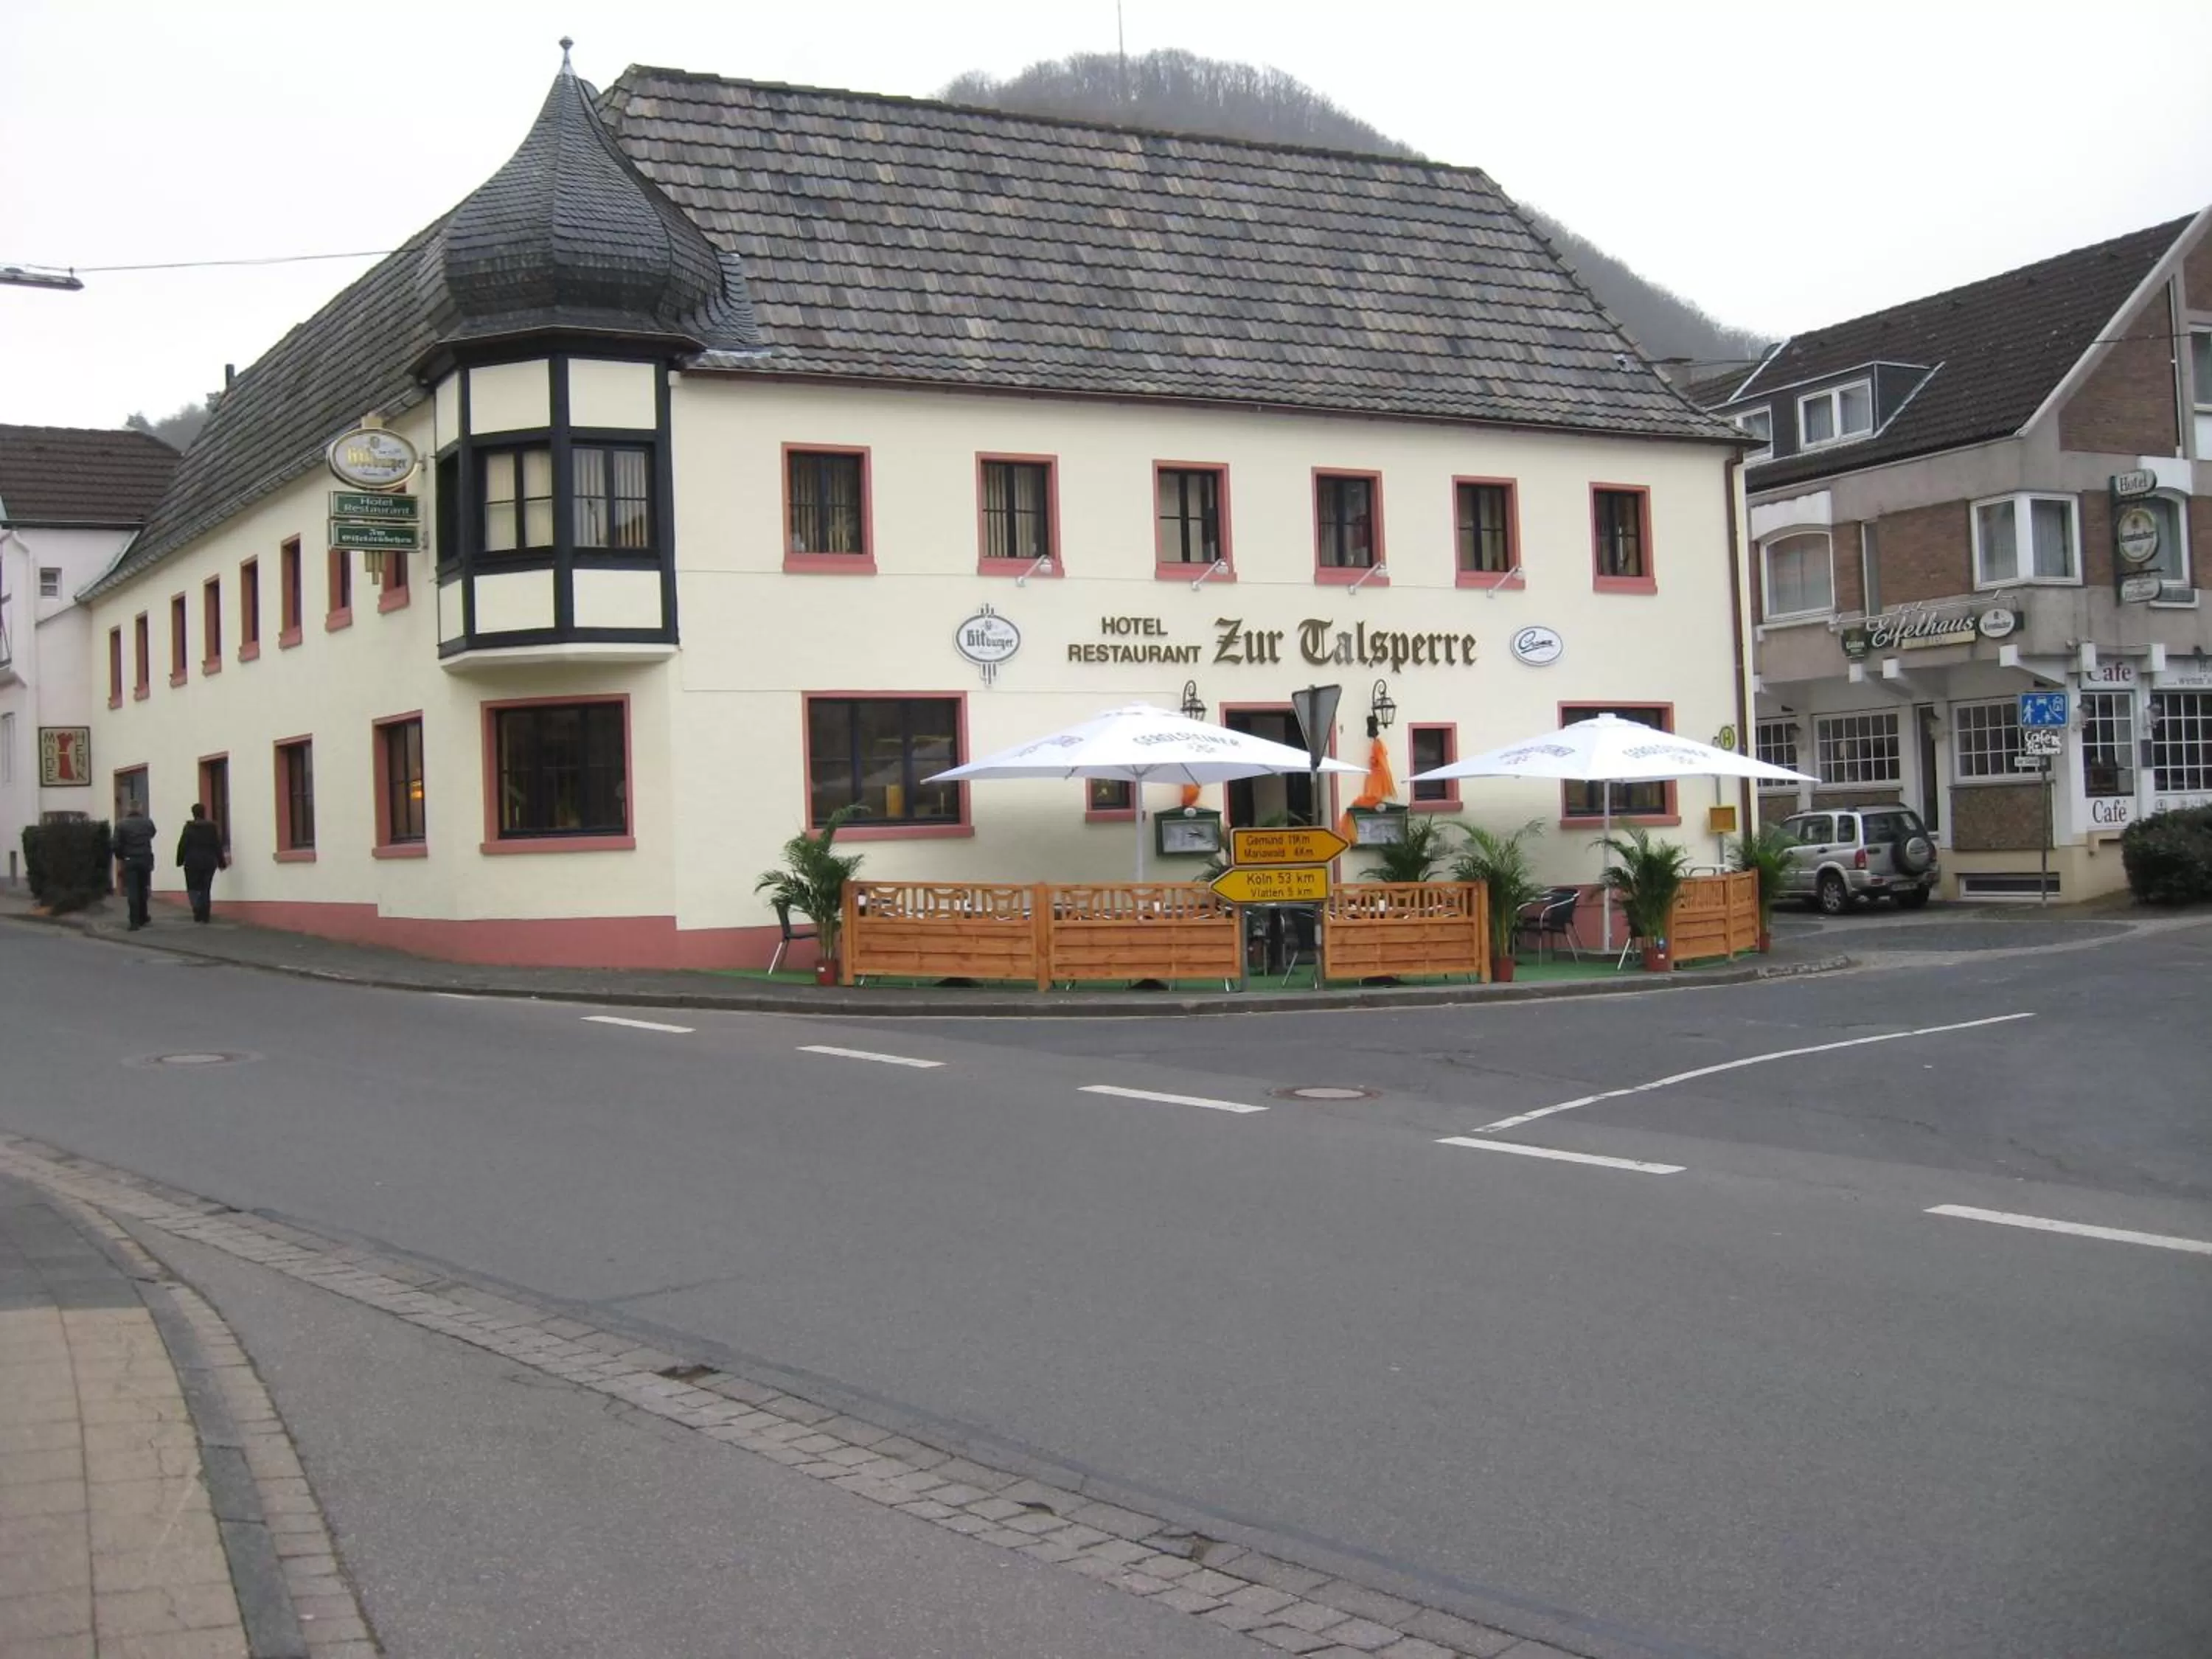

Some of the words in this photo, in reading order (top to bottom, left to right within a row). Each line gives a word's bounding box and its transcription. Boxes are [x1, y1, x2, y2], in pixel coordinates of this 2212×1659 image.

[2121, 476, 2148, 492] Hotel
[344, 504, 410, 515] Restaurant
[361, 498, 393, 507] Hotel
[1102, 616, 1169, 636] HOTEL
[1866, 611, 1976, 648] Eifelhaus
[967, 629, 1014, 651] Bitburger
[1213, 617, 1284, 664] Zur
[1298, 619, 1478, 674] Talsperre
[1068, 644, 1202, 663] RESTAURANT
[2092, 800, 2127, 824] Café
[1247, 872, 1272, 885] Köln
[1277, 872, 1291, 884] 53
[1297, 872, 1315, 884] km
[1251, 887, 1284, 897] Vlatten
[1298, 887, 1313, 896] km
